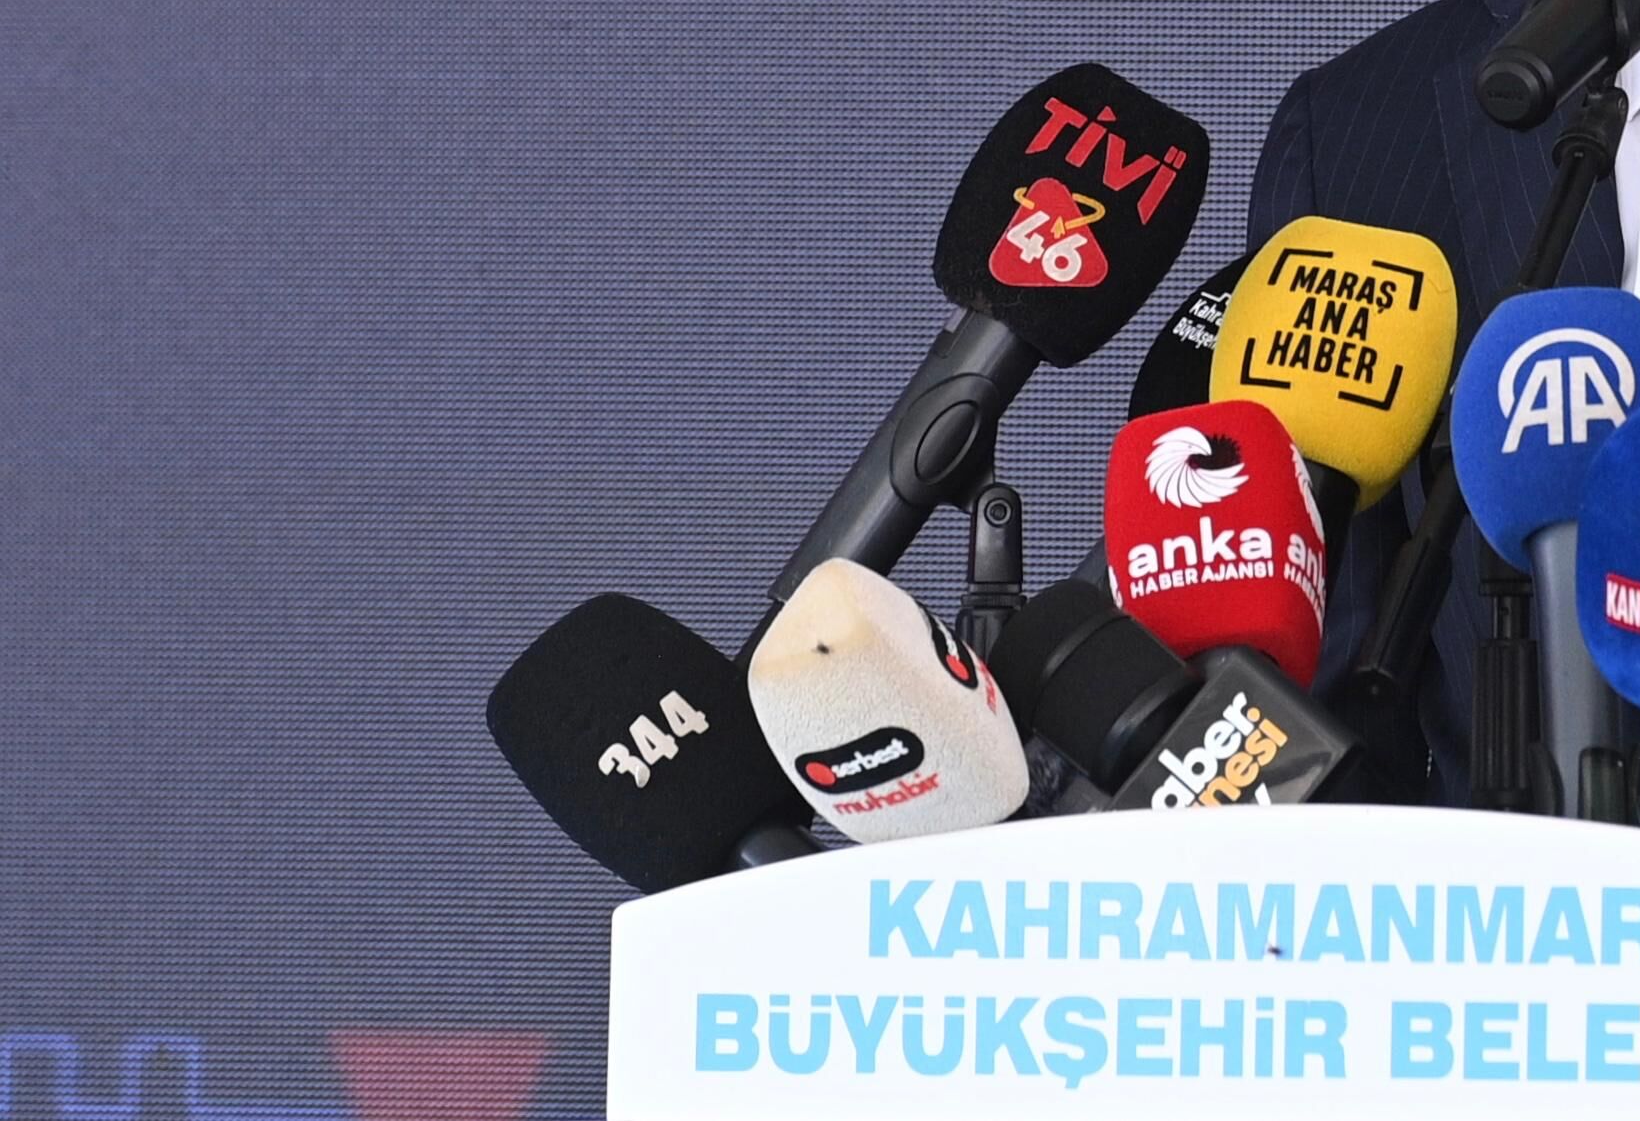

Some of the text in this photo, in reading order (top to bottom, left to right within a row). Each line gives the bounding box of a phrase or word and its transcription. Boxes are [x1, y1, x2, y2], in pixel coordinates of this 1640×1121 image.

[1007, 210, 1088, 282] 46
[1290, 265, 1397, 314] MARAŞ
[1294, 297, 1370, 341] ANA
[1267, 330, 1378, 384] HABER
[1500, 355, 1628, 454] AA
[1127, 516, 1273, 578] anka
[1130, 567, 1199, 599] HABER
[1201, 560, 1274, 583] AJANSI
[598, 690, 710, 789] 344
[1194, 707, 1289, 809] nesi
[833, 773, 939, 814] muhabir
[695, 992, 1348, 1089] BÜYÜKŞEHİR
